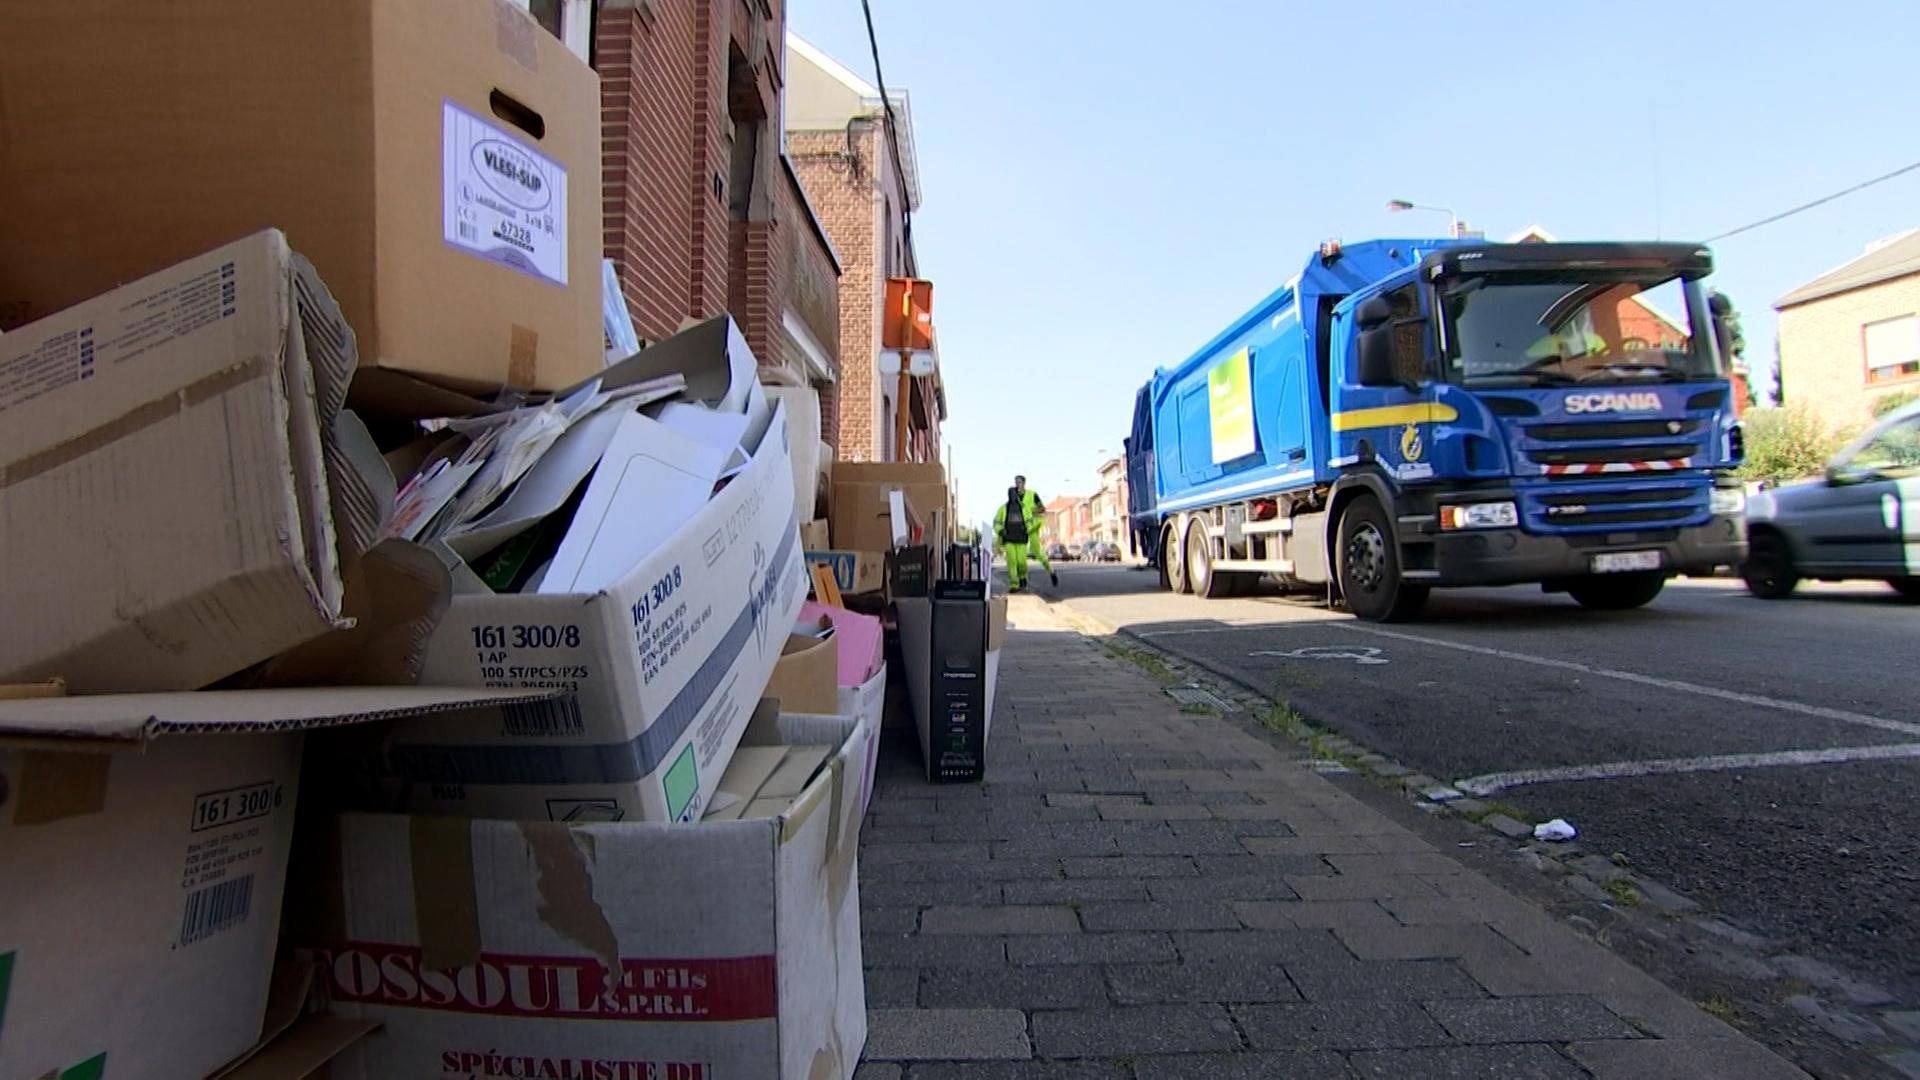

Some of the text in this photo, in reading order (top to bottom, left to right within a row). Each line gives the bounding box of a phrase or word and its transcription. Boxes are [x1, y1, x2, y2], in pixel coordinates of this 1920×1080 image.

[483, 148, 542, 194] VLESI-SLIP
[500, 220, 531, 244] 67328
[1565, 392, 1663, 414] SCANIA
[631, 594, 649, 626] 161
[471, 625, 580, 649] 161 300/8
[477, 651, 507, 664] 1 AP
[481, 665, 589, 679] 100 ST/PCS/PZS
[432, 784, 466, 800] PLUS
[199, 798, 229, 824] 161
[237, 789, 269, 817] 300
[643, 968, 707, 992] Fils
[604, 993, 709, 1017] S.P.R.L.
[442, 1047, 659, 1080] SPÉCIALISTE
